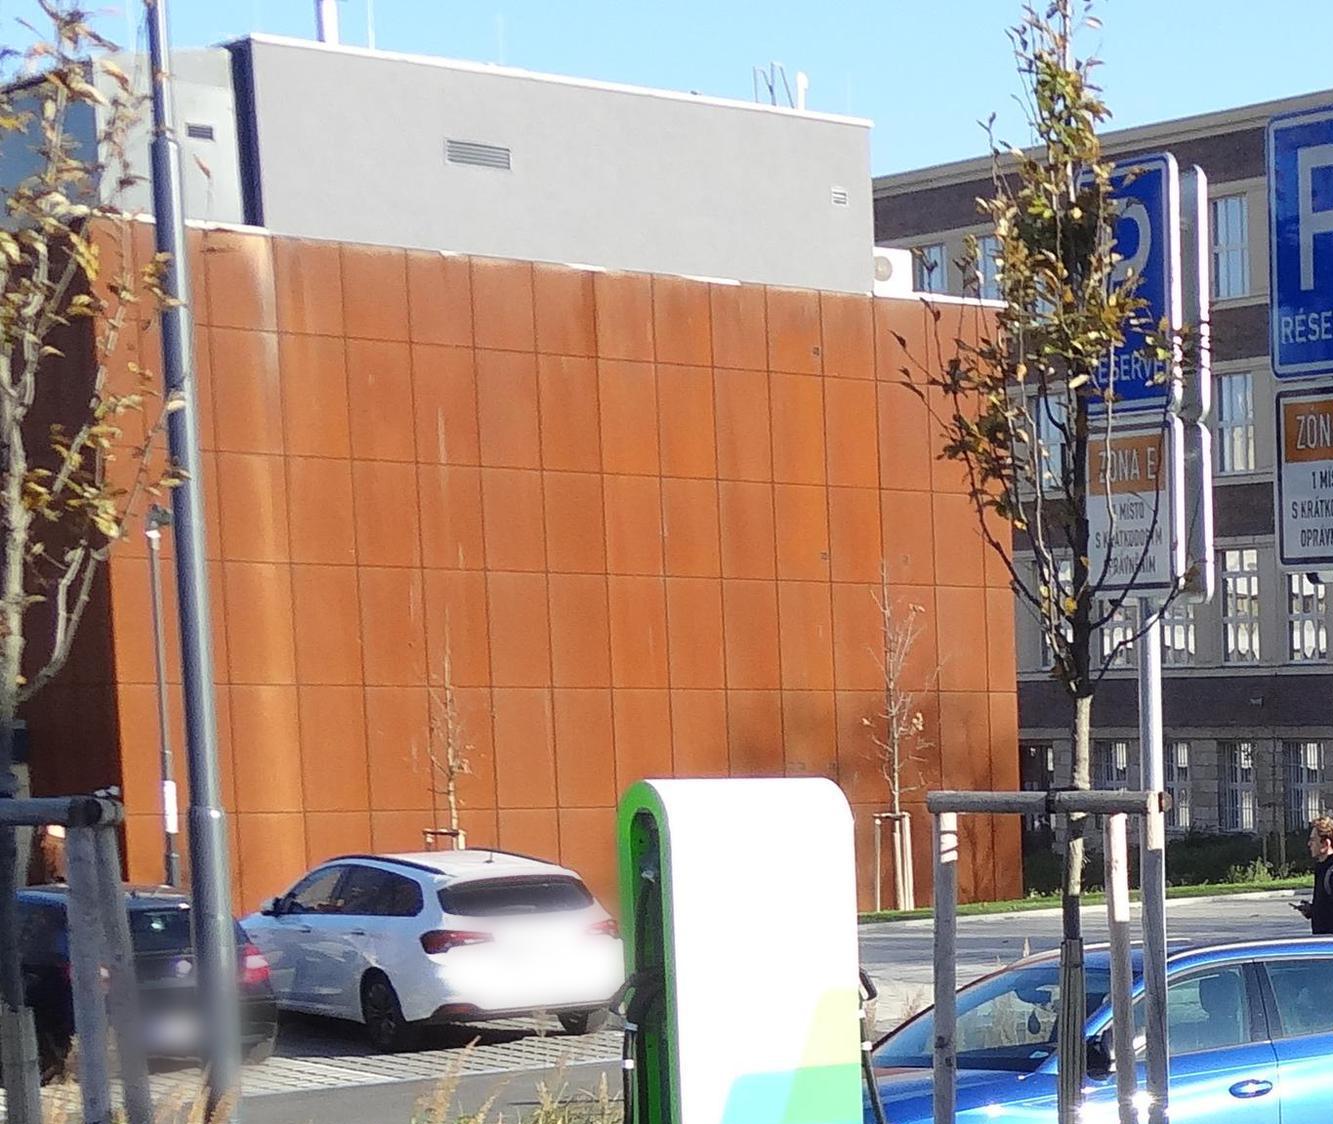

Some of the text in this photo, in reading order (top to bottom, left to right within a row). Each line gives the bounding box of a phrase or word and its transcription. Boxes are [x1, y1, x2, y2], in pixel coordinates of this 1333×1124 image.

[1147, 447, 1156, 480] E
[1312, 471, 1317, 489] 1
[1292, 501, 1298, 519] S
[1095, 532, 1101, 549] S
